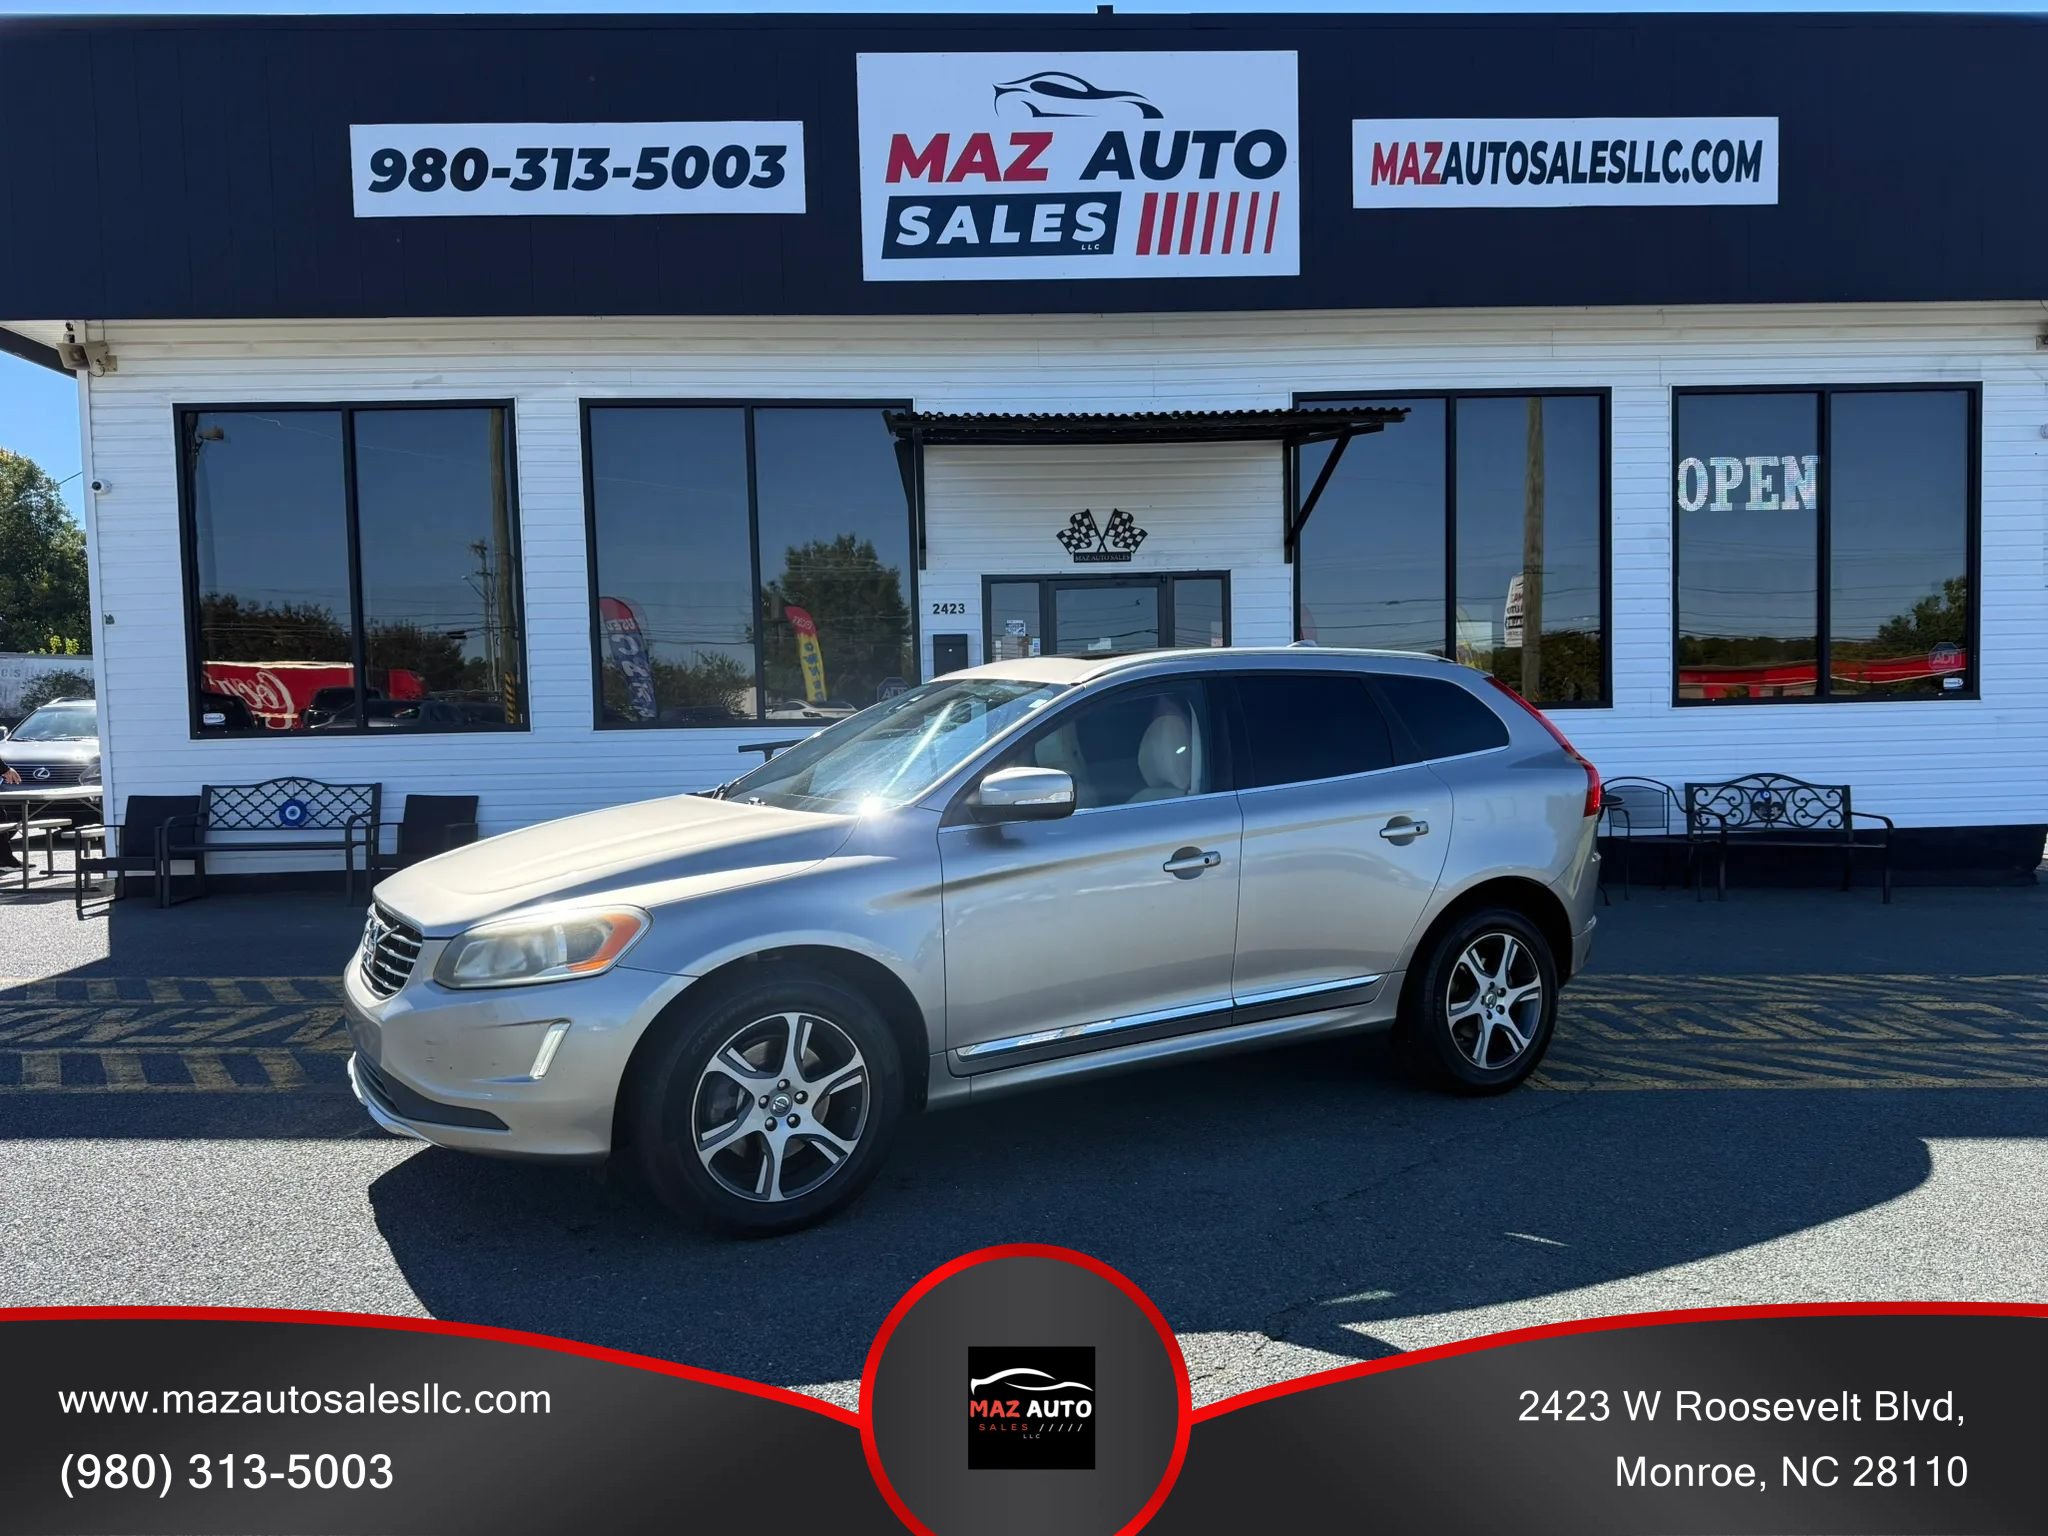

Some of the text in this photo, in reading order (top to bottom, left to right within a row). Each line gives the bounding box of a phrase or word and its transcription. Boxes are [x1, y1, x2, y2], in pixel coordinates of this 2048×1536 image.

[368, 144, 788, 193] 980-313-5003
[885, 128, 1288, 184] MAZ AUTO
[1371, 138, 1763, 186] MAZAUTOSALESLLC.COM
[895, 201, 1108, 247] SALES
[1081, 243, 1101, 251] LLC
[1678, 455, 1820, 513] OPEN
[1091, 554, 1110, 562] AUTO
[1110, 553, 1131, 561] SALES
[932, 602, 966, 615] 2423
[1932, 651, 1958, 665] ADT
